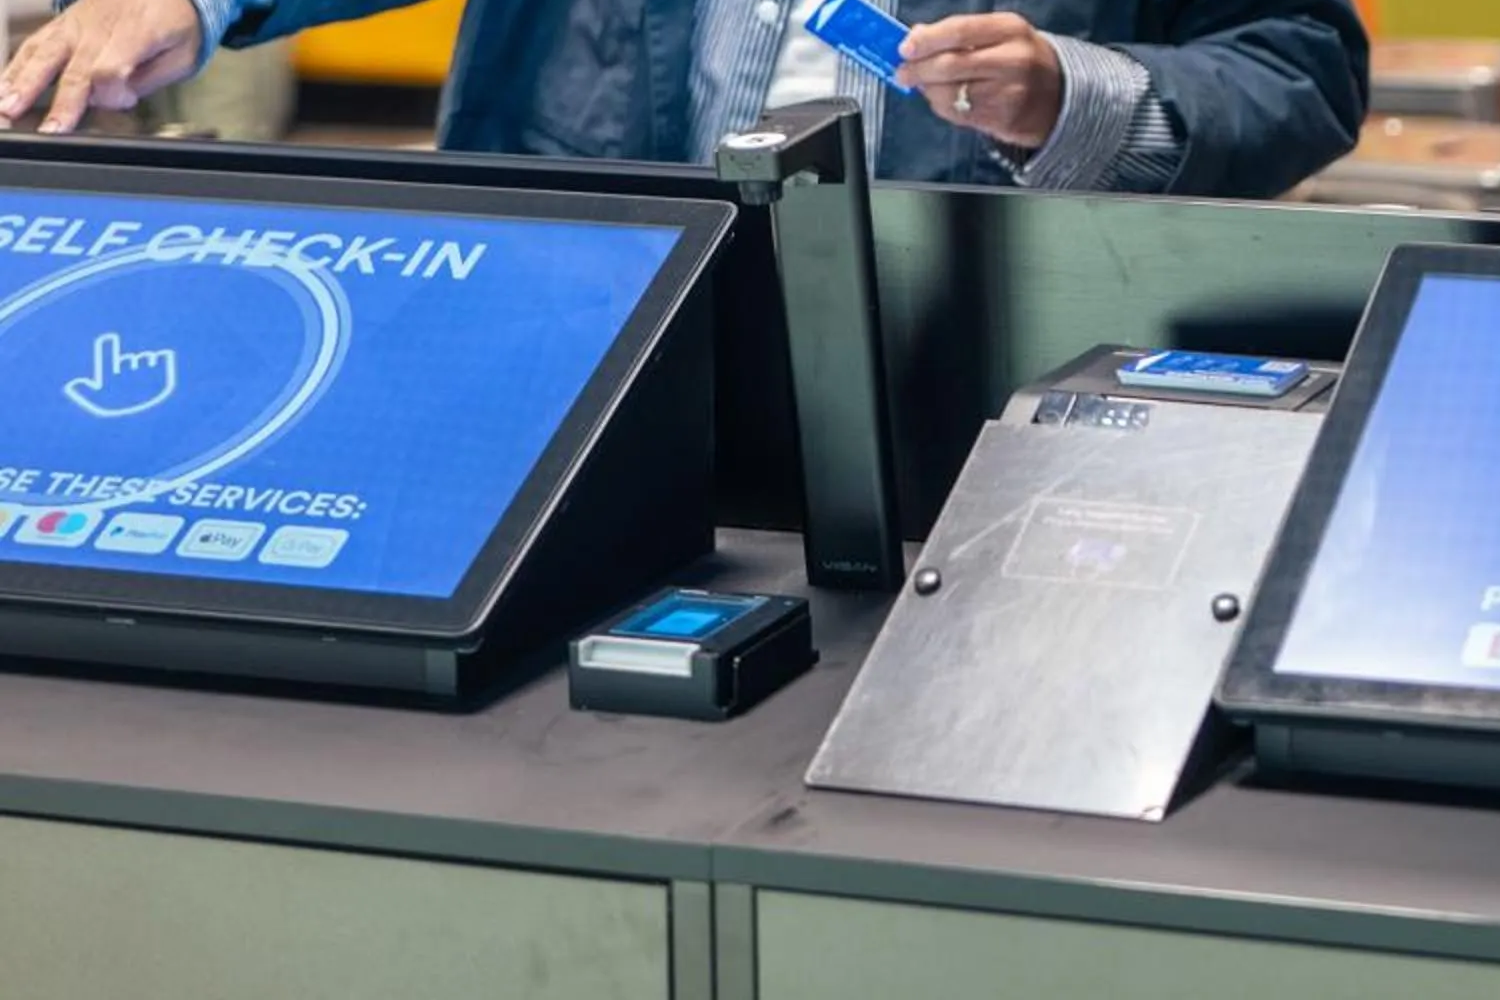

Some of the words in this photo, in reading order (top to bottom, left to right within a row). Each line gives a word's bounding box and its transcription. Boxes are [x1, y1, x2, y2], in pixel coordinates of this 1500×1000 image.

[0, 214, 142, 257] SELF
[144, 224, 487, 280] CHECK-IN
[0, 466, 42, 491] SE
[46, 470, 168, 503] THESE
[169, 480, 369, 520] SERVICES:
